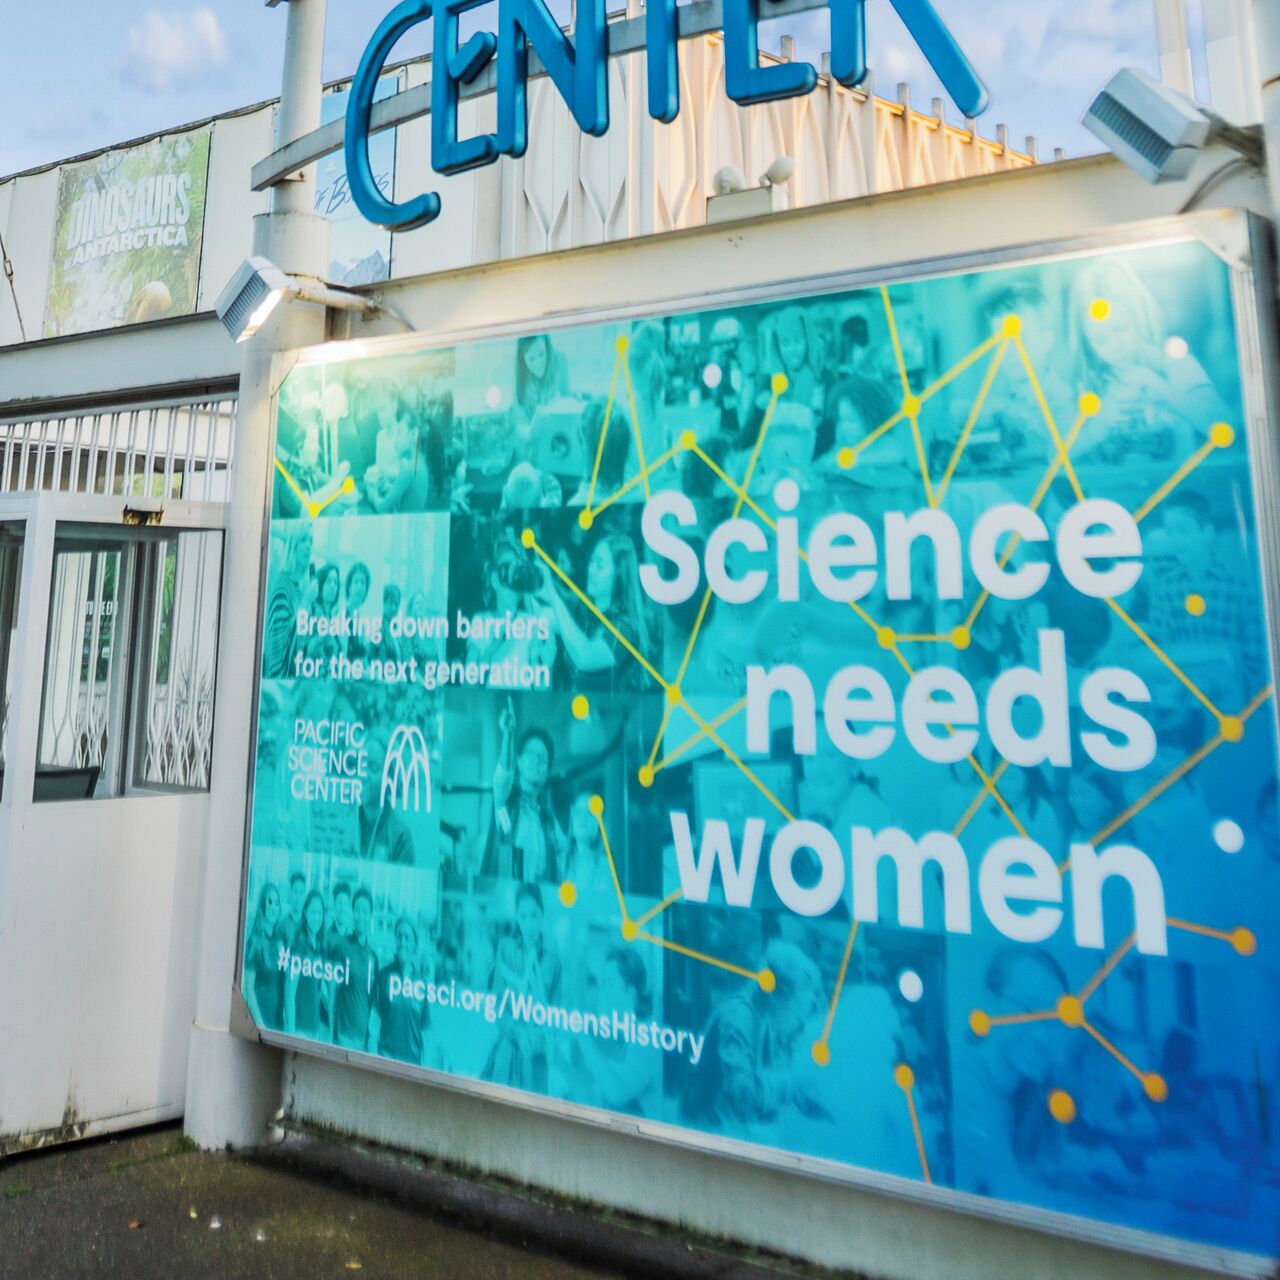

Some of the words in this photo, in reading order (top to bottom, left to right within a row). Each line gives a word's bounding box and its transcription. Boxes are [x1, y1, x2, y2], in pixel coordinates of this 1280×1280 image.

[67, 173, 191, 251] DINOSAURS
[73, 226, 188, 266] ANTARCTICA
[638, 477, 1144, 605] Science
[296, 608, 382, 644] Breaking
[389, 610, 449, 638] down
[456, 609, 549, 640] barriers
[294, 650, 323, 678] for
[329, 651, 364, 680] the
[370, 655, 417, 683] next
[423, 657, 550, 690] generation
[745, 628, 1158, 772] needs
[294, 718, 364, 748] PACIFIC
[288, 745, 368, 778] SCIENCE
[290, 772, 363, 806] CENTER
[668, 810, 1168, 957] women
[277, 945, 350, 985] #pacsci
[389, 974, 704, 1065] pacsci.org/WomensHistory
